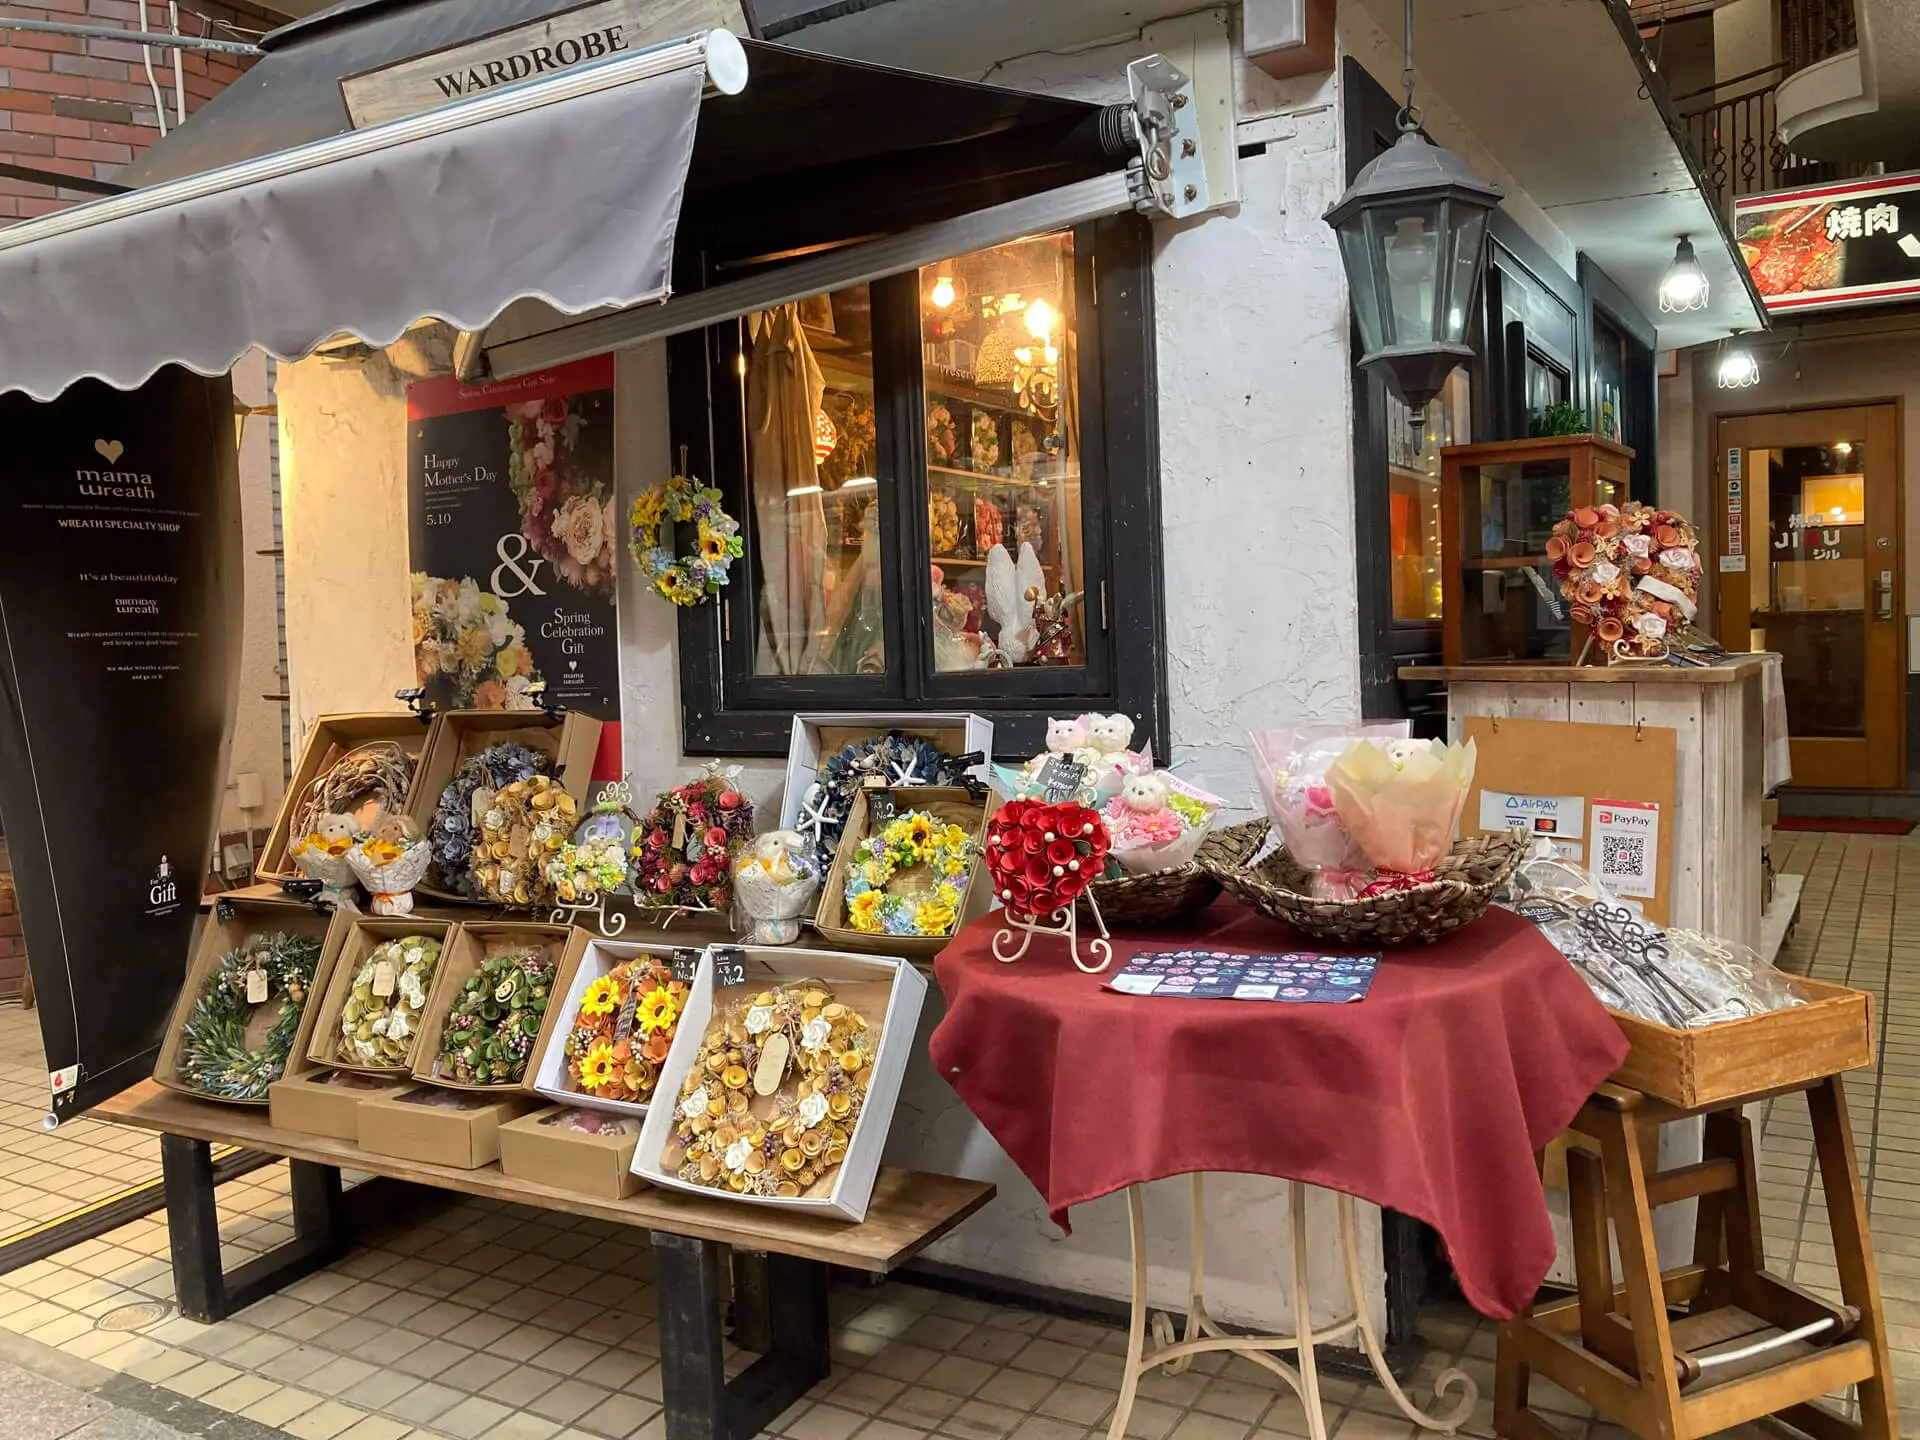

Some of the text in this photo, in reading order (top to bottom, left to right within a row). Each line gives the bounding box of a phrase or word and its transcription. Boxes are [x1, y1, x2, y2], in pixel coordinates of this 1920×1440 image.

[433, 24, 629, 97] WARDROBE
[1825, 203, 1899, 240] 焼肉
[423, 454, 460, 470] Happy
[76, 469, 152, 485] mama
[423, 466, 498, 488] Mother's Day
[79, 484, 155, 500] wreath
[57, 518, 181, 533] WREATH SPECIALTY SHOP
[426, 513, 452, 526] 5.10
[1812, 547, 1841, 560] ジル
[490, 533, 547, 598] &
[115, 598, 158, 607] BIRTHDAY
[116, 605, 159, 615] wreath
[554, 607, 591, 626] Spring
[540, 622, 604, 638] Celebration
[561, 638, 584, 654] Gift
[1520, 799, 1559, 810] AirPAY
[1614, 814, 1650, 828] PayPay
[150, 882, 177, 905] Gift
